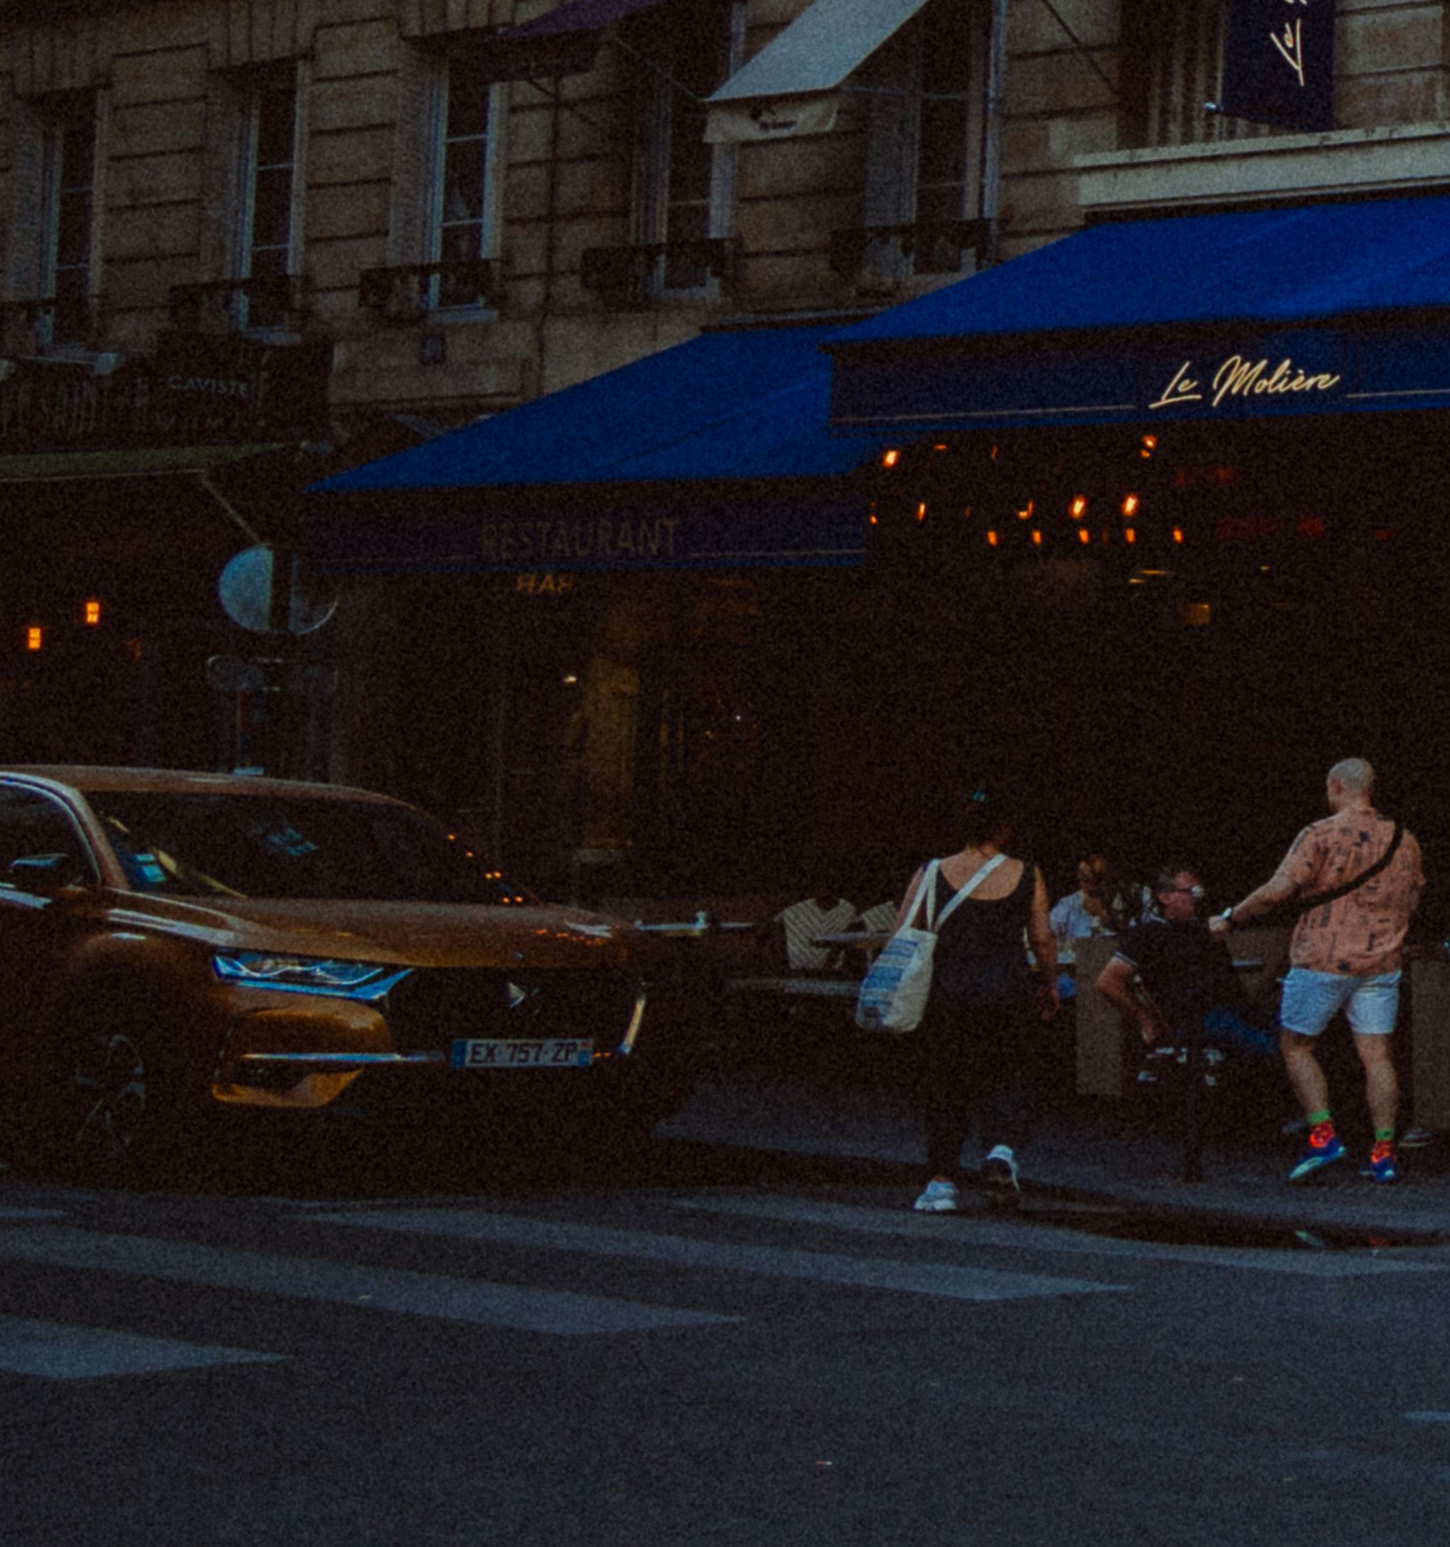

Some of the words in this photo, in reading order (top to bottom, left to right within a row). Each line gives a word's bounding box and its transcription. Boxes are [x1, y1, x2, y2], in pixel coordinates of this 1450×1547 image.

[1269, 21, 1305, 87] Le
[167, 375, 249, 398] CAVISTE
[1149, 361, 1202, 409] Le
[1211, 355, 1342, 408] Molière
[480, 516, 681, 561] RESTAURANT
